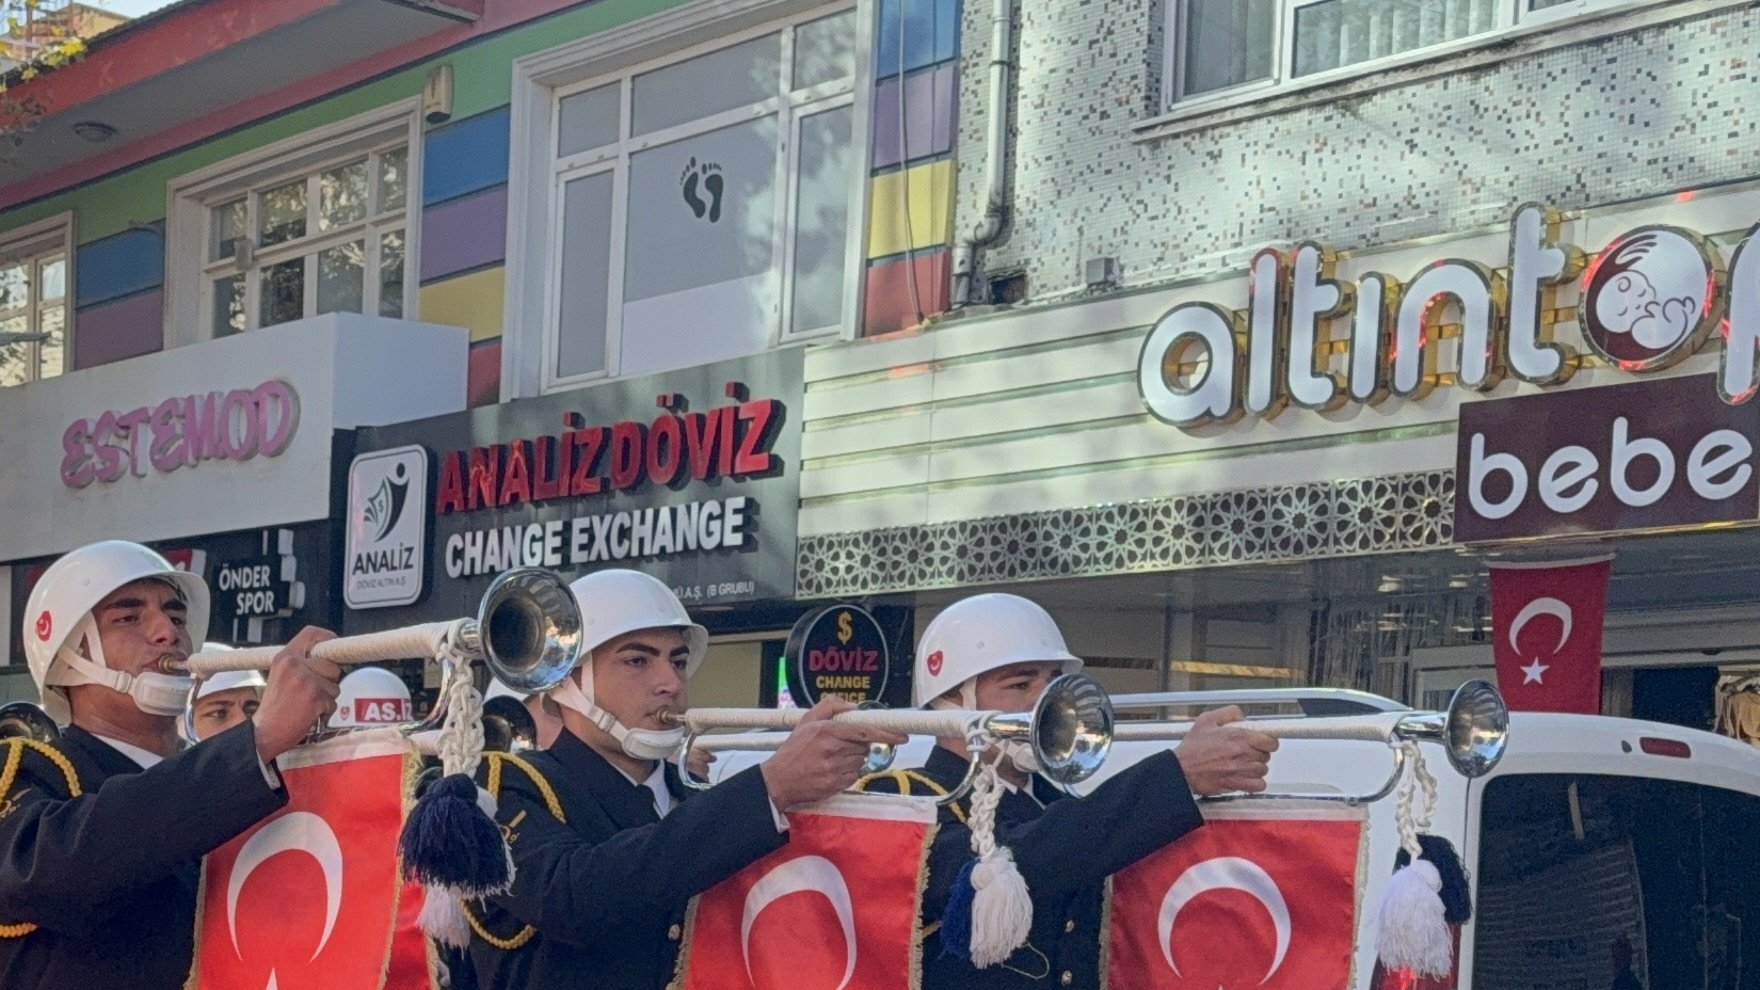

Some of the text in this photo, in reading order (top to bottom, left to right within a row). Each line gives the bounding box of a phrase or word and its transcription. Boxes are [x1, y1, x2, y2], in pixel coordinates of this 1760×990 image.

[59, 379, 300, 489] ESTEMOD
[1468, 416, 1753, 520] bebe
[444, 496, 746, 579] CHANGE EXCHANGE
[352, 542, 415, 576] ANALİZ
[218, 563, 271, 592] ÖNDER
[236, 591, 274, 615] SPOR
[809, 646, 879, 672] DÖVİZ
[815, 675, 871, 689] CHANGE
